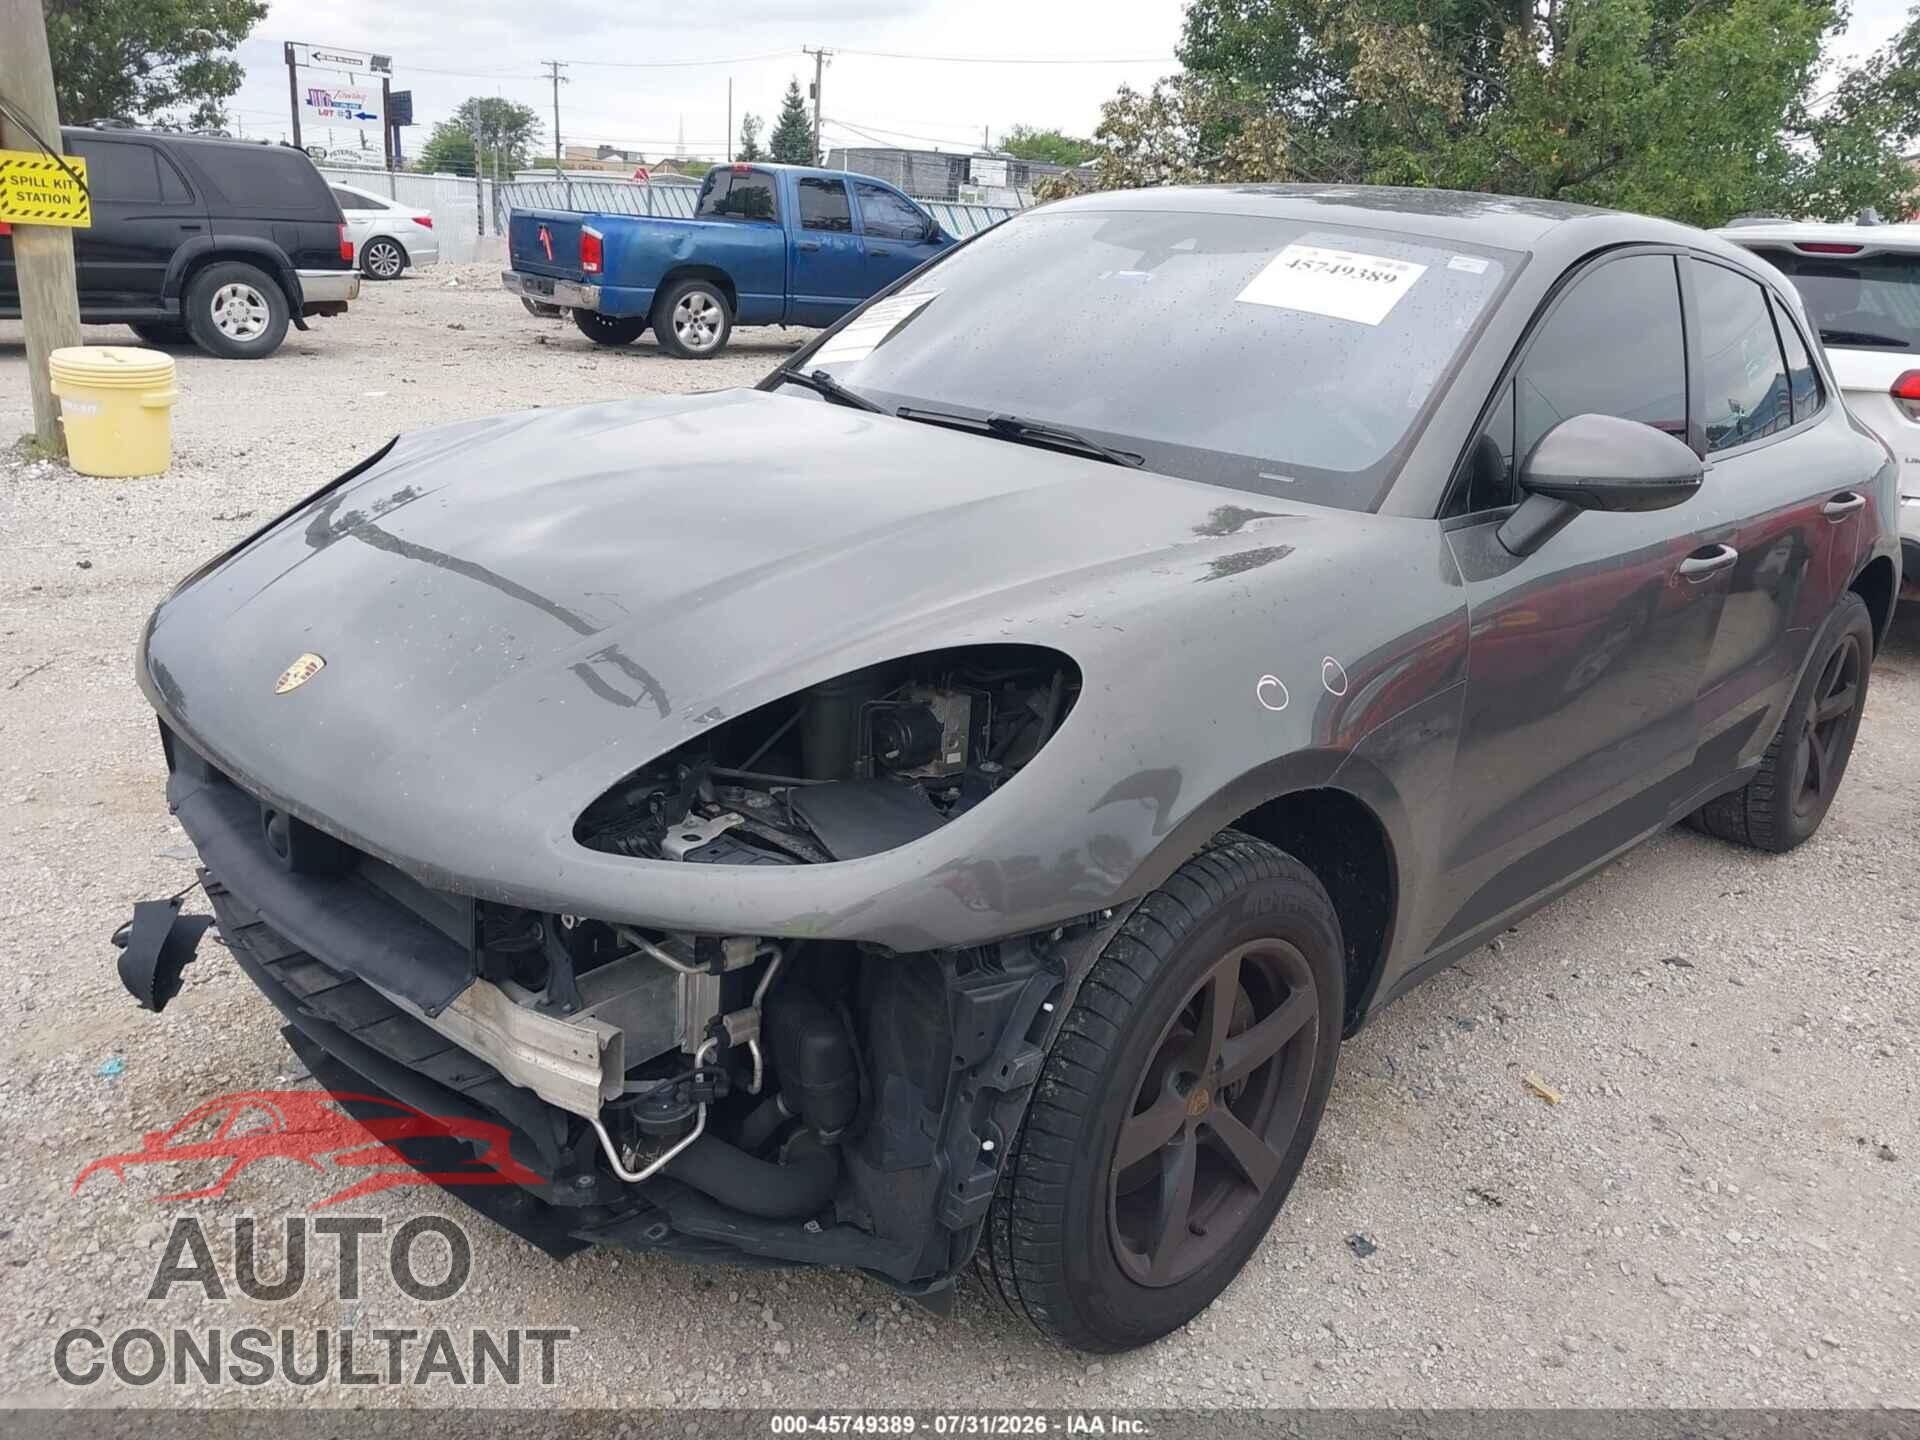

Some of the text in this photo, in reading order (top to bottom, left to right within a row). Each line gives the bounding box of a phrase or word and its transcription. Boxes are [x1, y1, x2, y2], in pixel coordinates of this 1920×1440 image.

[318, 109, 334, 118] LOT
[10, 175, 73, 190] SPILL KIT
[16, 191, 72, 205] STATION
[1285, 258, 1398, 283] 45749389
